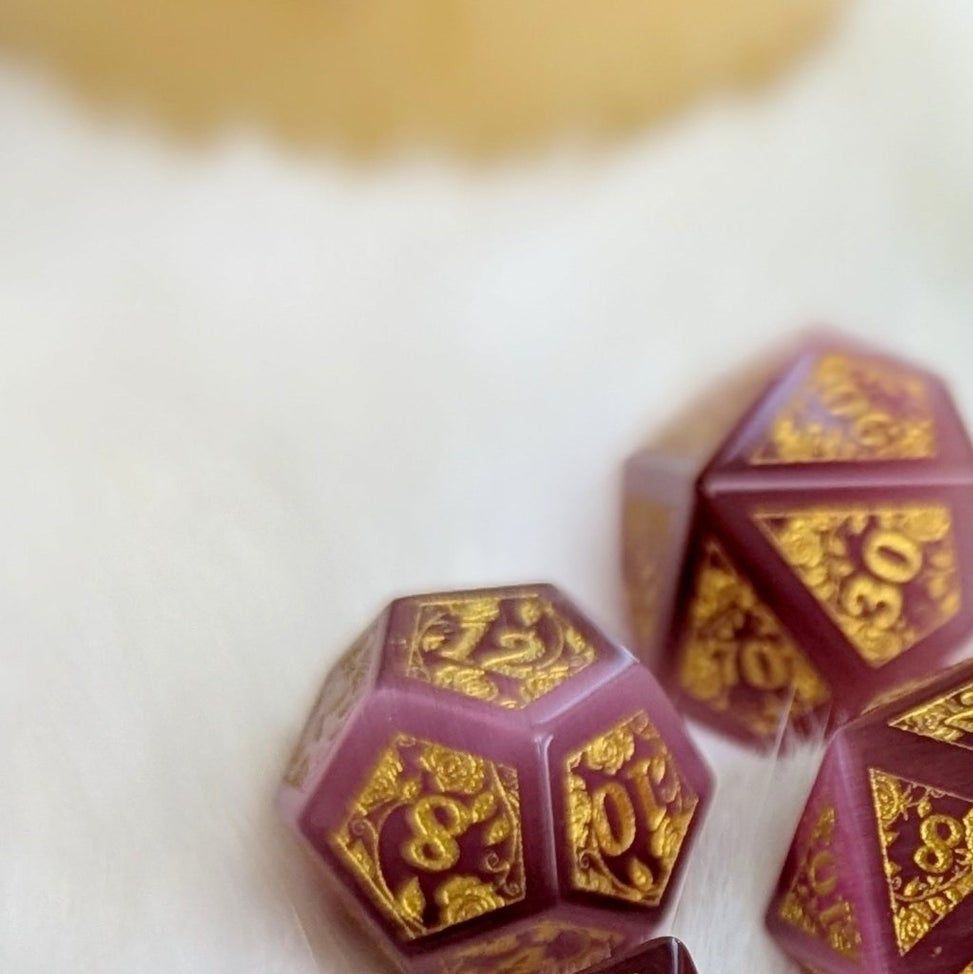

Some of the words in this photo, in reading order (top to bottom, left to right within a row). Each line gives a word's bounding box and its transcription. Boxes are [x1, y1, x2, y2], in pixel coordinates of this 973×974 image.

[843, 530, 924, 628] 30
[440, 620, 546, 682] 12
[405, 796, 468, 871] 8
[591, 757, 668, 857] 10
[914, 814, 964, 874] 8
